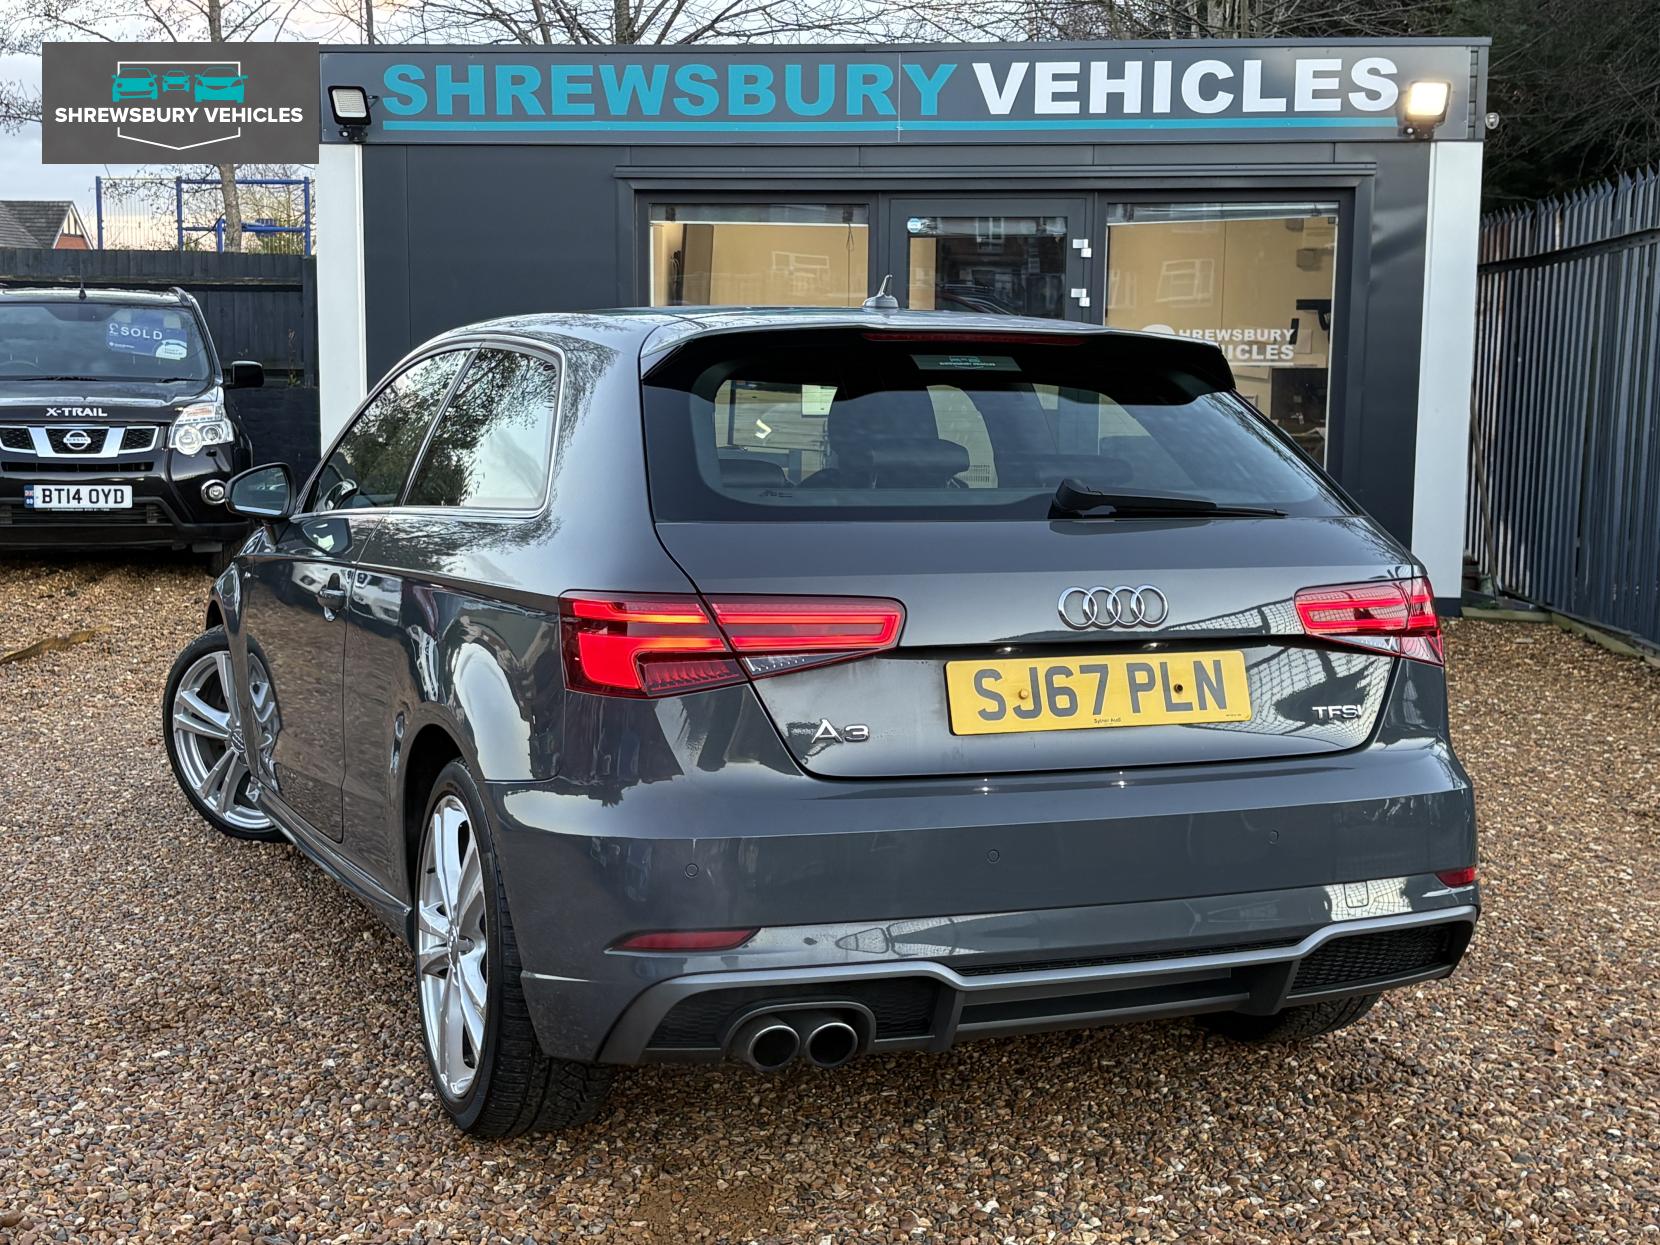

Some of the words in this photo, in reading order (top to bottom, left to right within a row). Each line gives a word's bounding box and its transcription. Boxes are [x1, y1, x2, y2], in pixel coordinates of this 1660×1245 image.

[383, 63, 957, 116] SHREWSBURY
[972, 57, 1399, 115] VEHICLES
[46, 408, 108, 417] X-TRAIL
[42, 488, 82, 504] BT14
[89, 488, 124, 504] OYD
[973, 663, 1109, 721] SJ67
[1126, 659, 1227, 714] PLN
[1312, 704, 1362, 719] TFSI
[811, 719, 869, 743] A3
